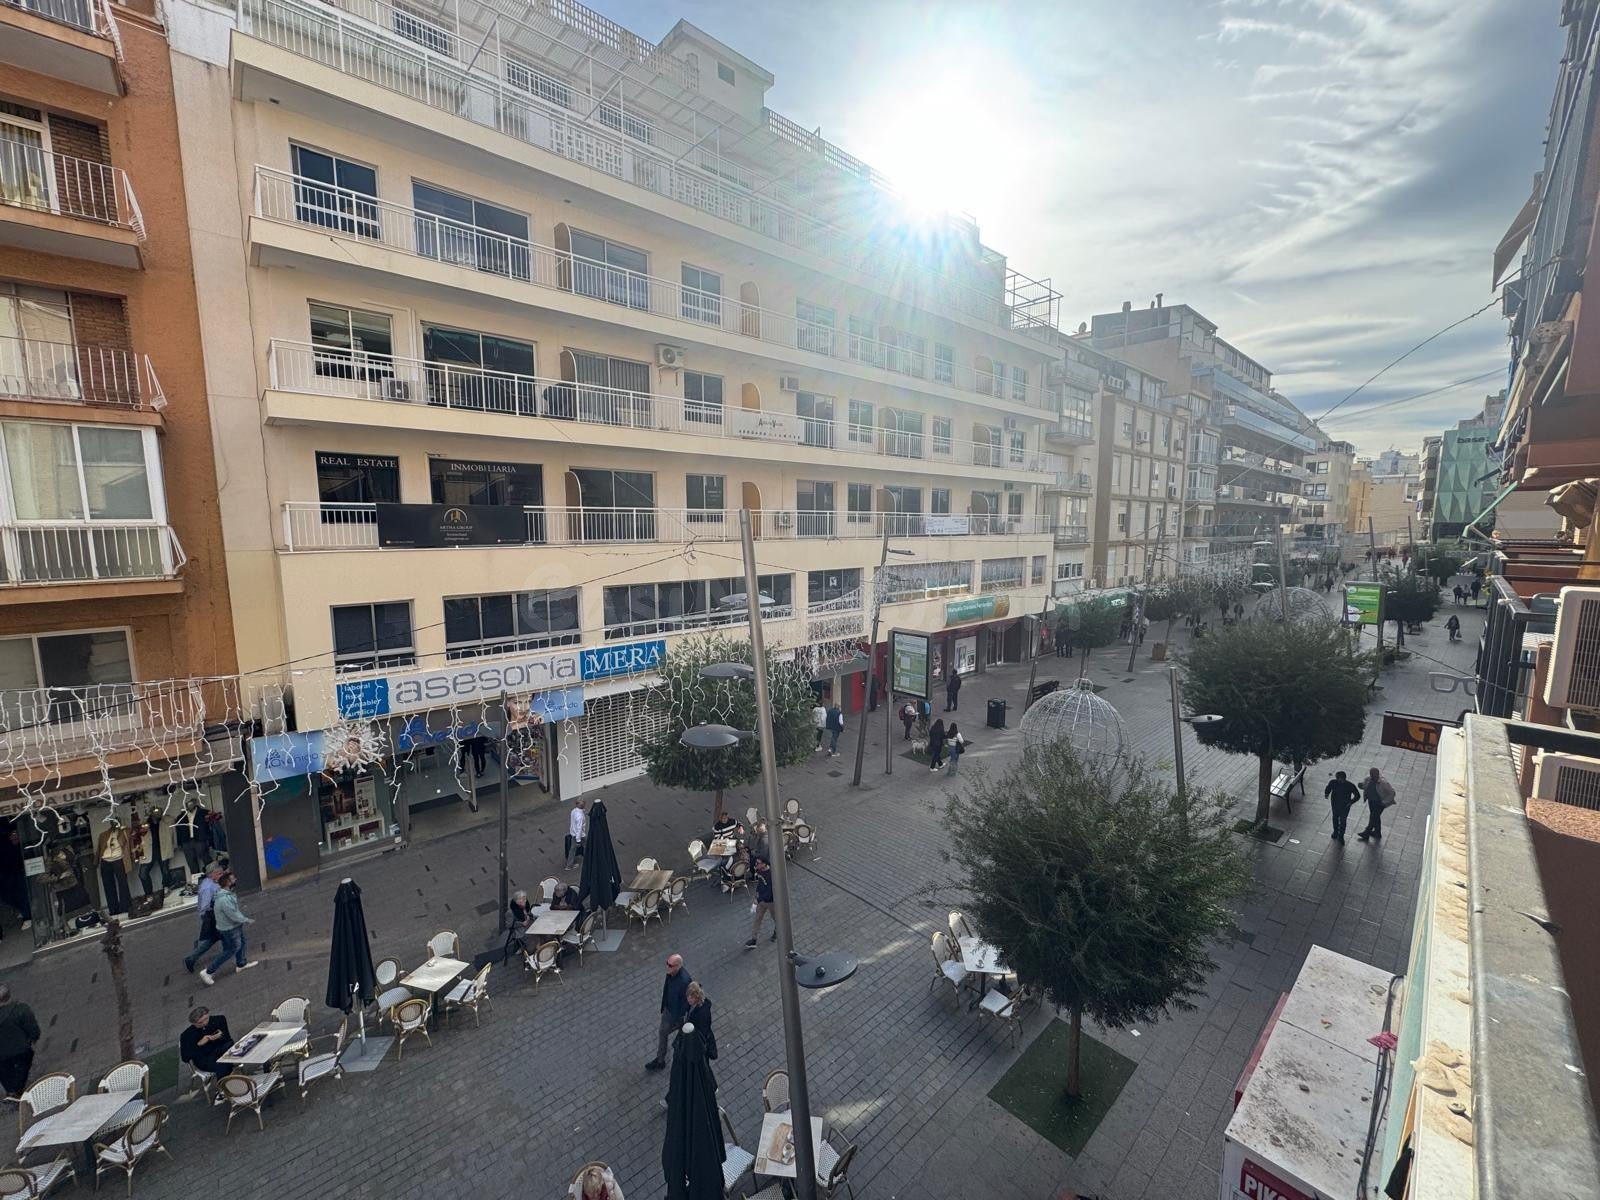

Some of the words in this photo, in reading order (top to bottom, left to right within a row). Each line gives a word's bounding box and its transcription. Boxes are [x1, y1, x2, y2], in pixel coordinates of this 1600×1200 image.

[320, 456, 351, 466] REAL
[357, 458, 397, 468] ESTATE
[450, 463, 516, 473] INMOBILIARIA
[396, 656, 575, 704] asesoría
[586, 646, 660, 674] MERA
[63, 788, 101, 802] UNO
[1244, 1173, 1288, 1200] PIK
